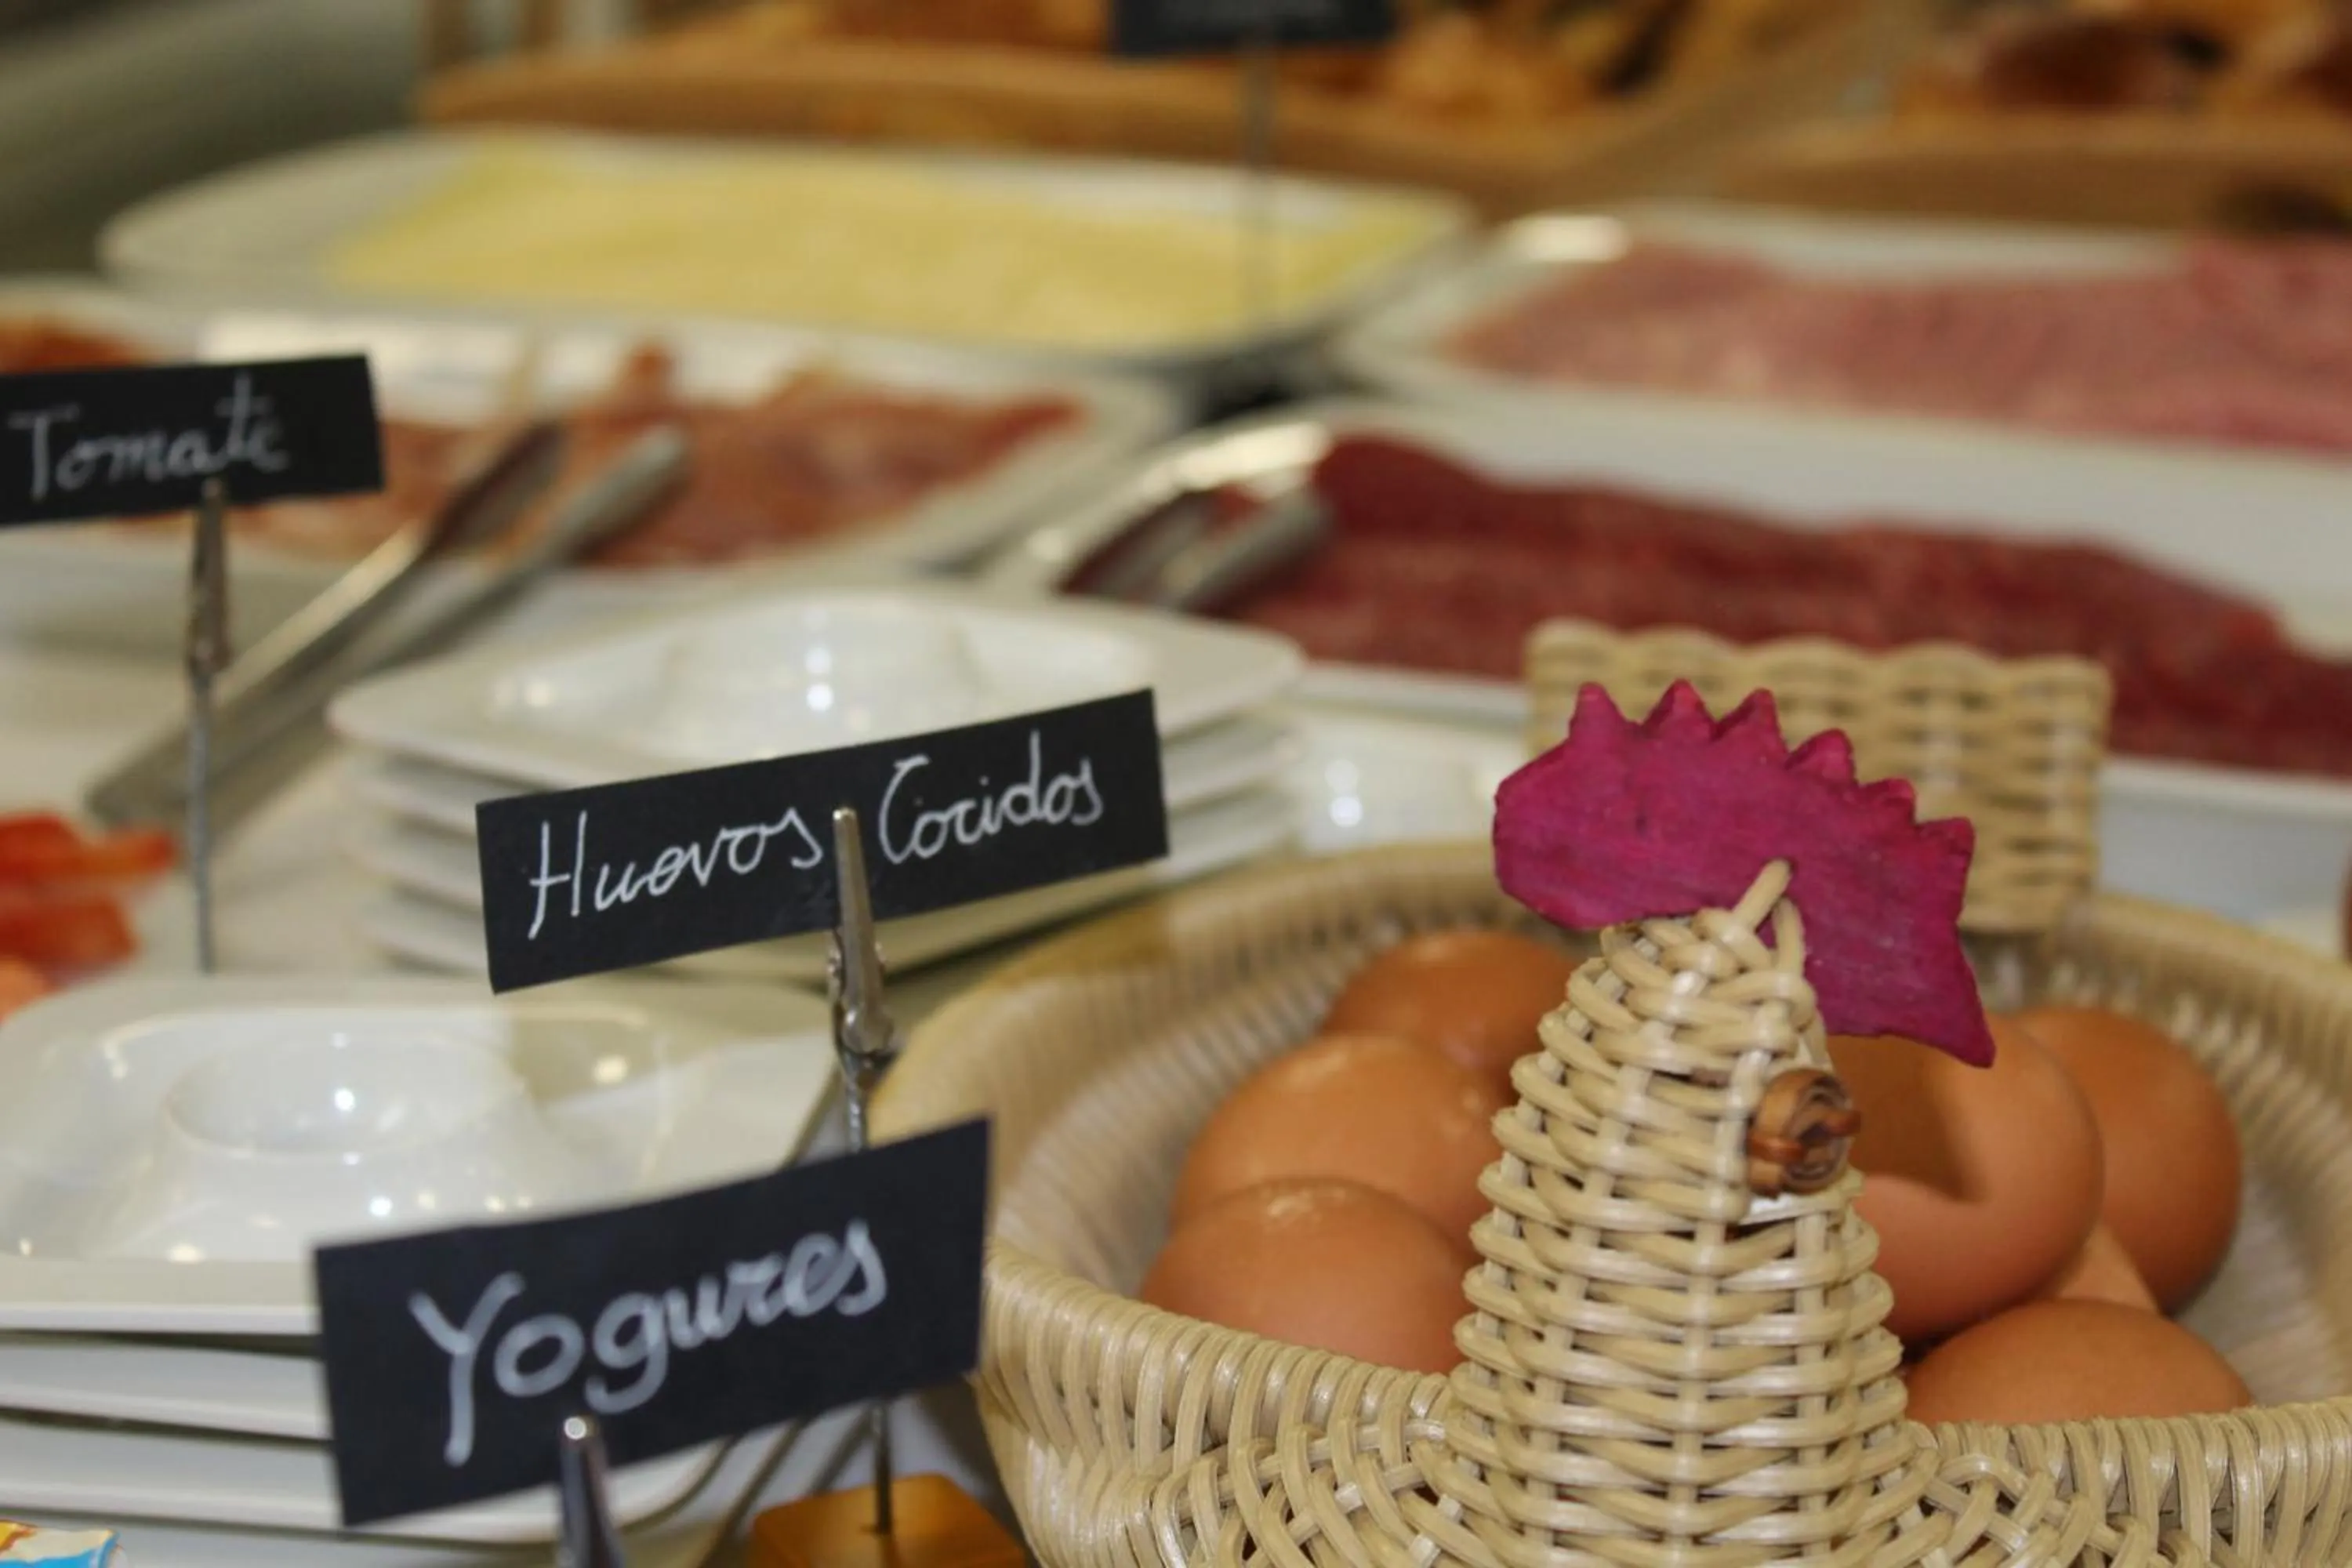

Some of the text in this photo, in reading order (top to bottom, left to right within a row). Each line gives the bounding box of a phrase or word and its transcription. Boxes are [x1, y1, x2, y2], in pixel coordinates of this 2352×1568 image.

[7, 368, 290, 502] Tomate
[528, 730, 1104, 940] Huevos Cocidos
[408, 1218, 888, 1468] Yogures
